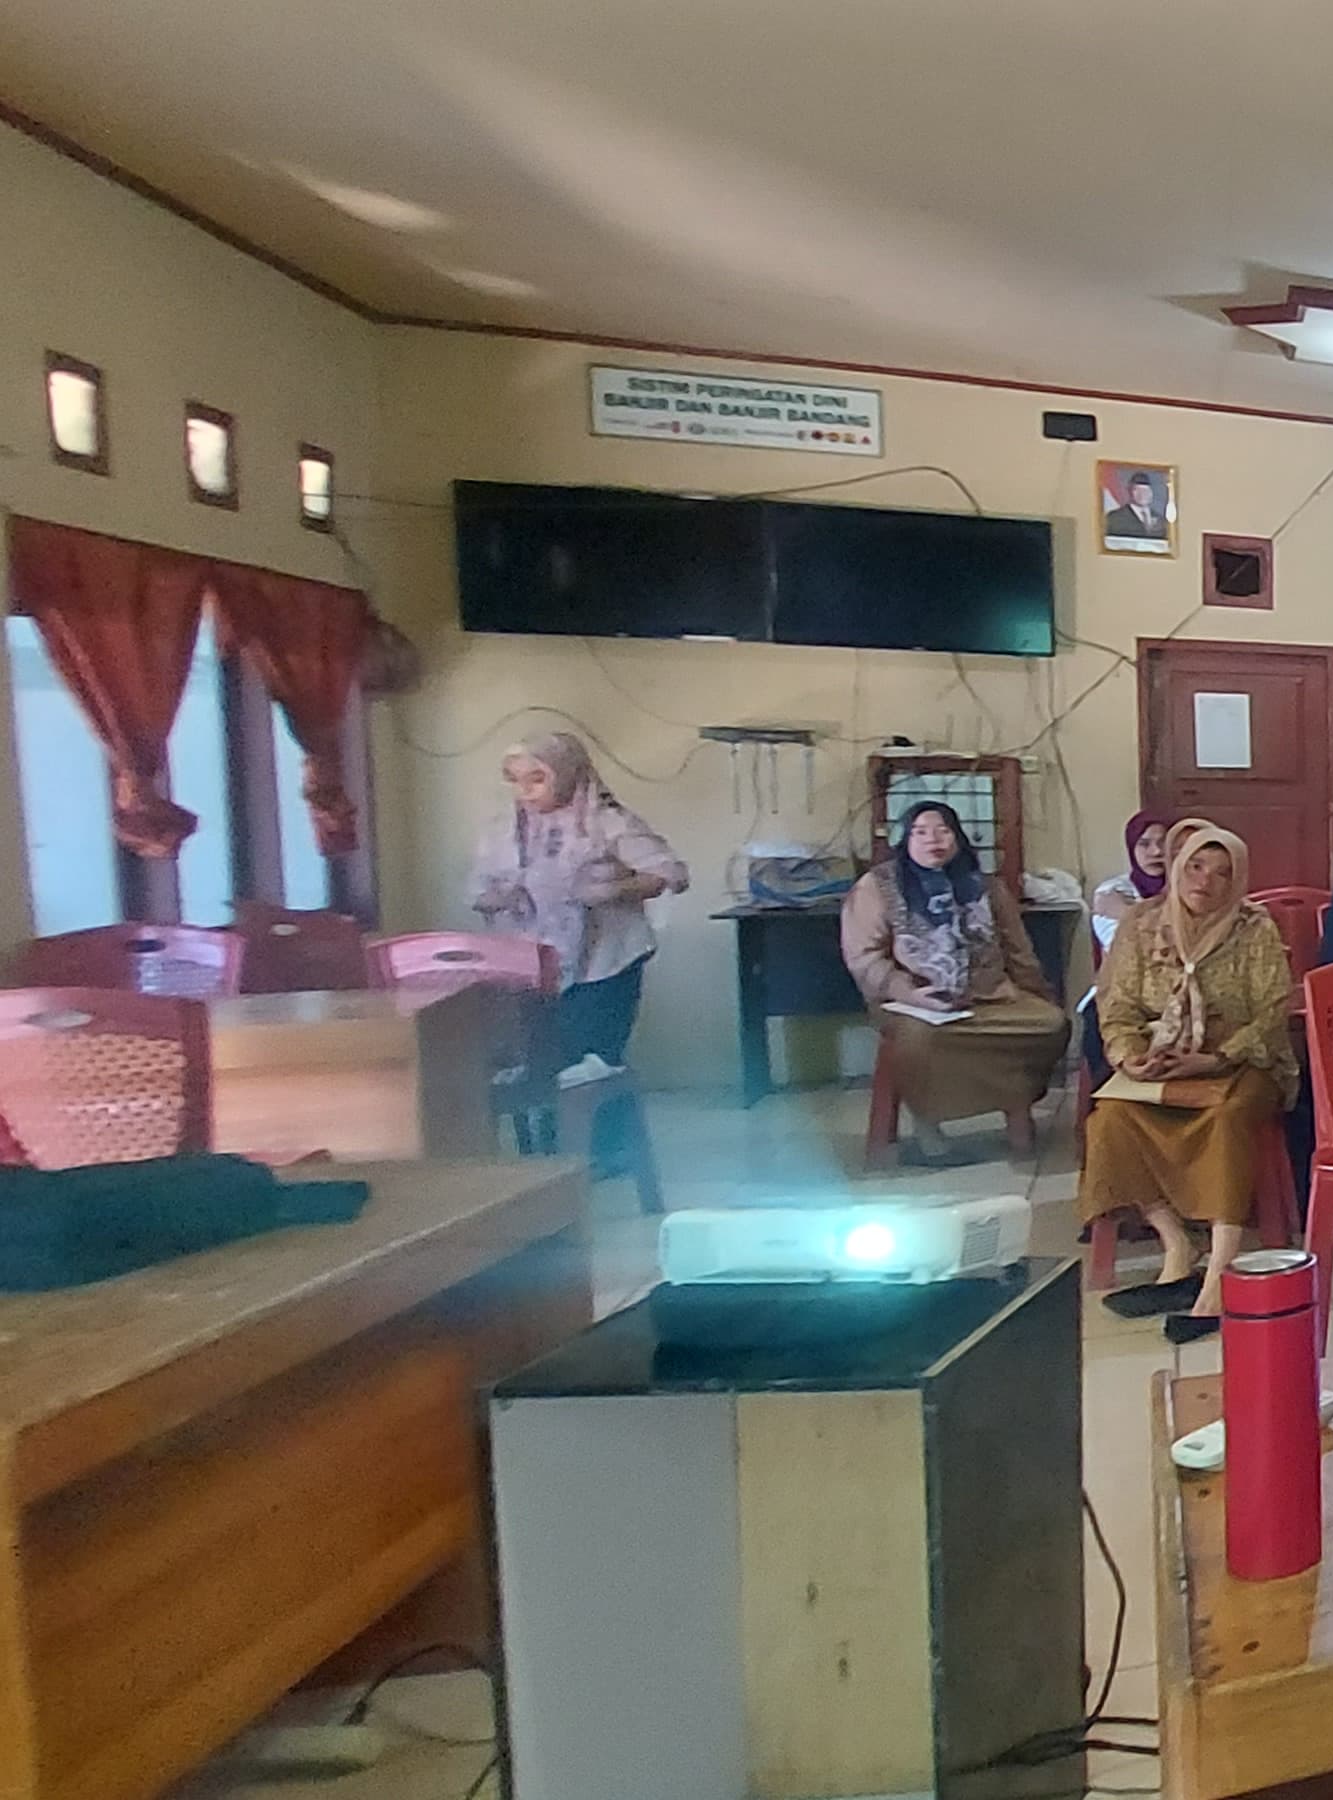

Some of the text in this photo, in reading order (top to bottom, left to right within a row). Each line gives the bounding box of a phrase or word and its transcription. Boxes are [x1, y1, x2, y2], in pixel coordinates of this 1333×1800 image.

[604, 393, 871, 428] BANJIR DAN BANJIR BANDANG
[696, 383, 807, 404] PERINGATAN
[812, 394, 848, 408] DINI
